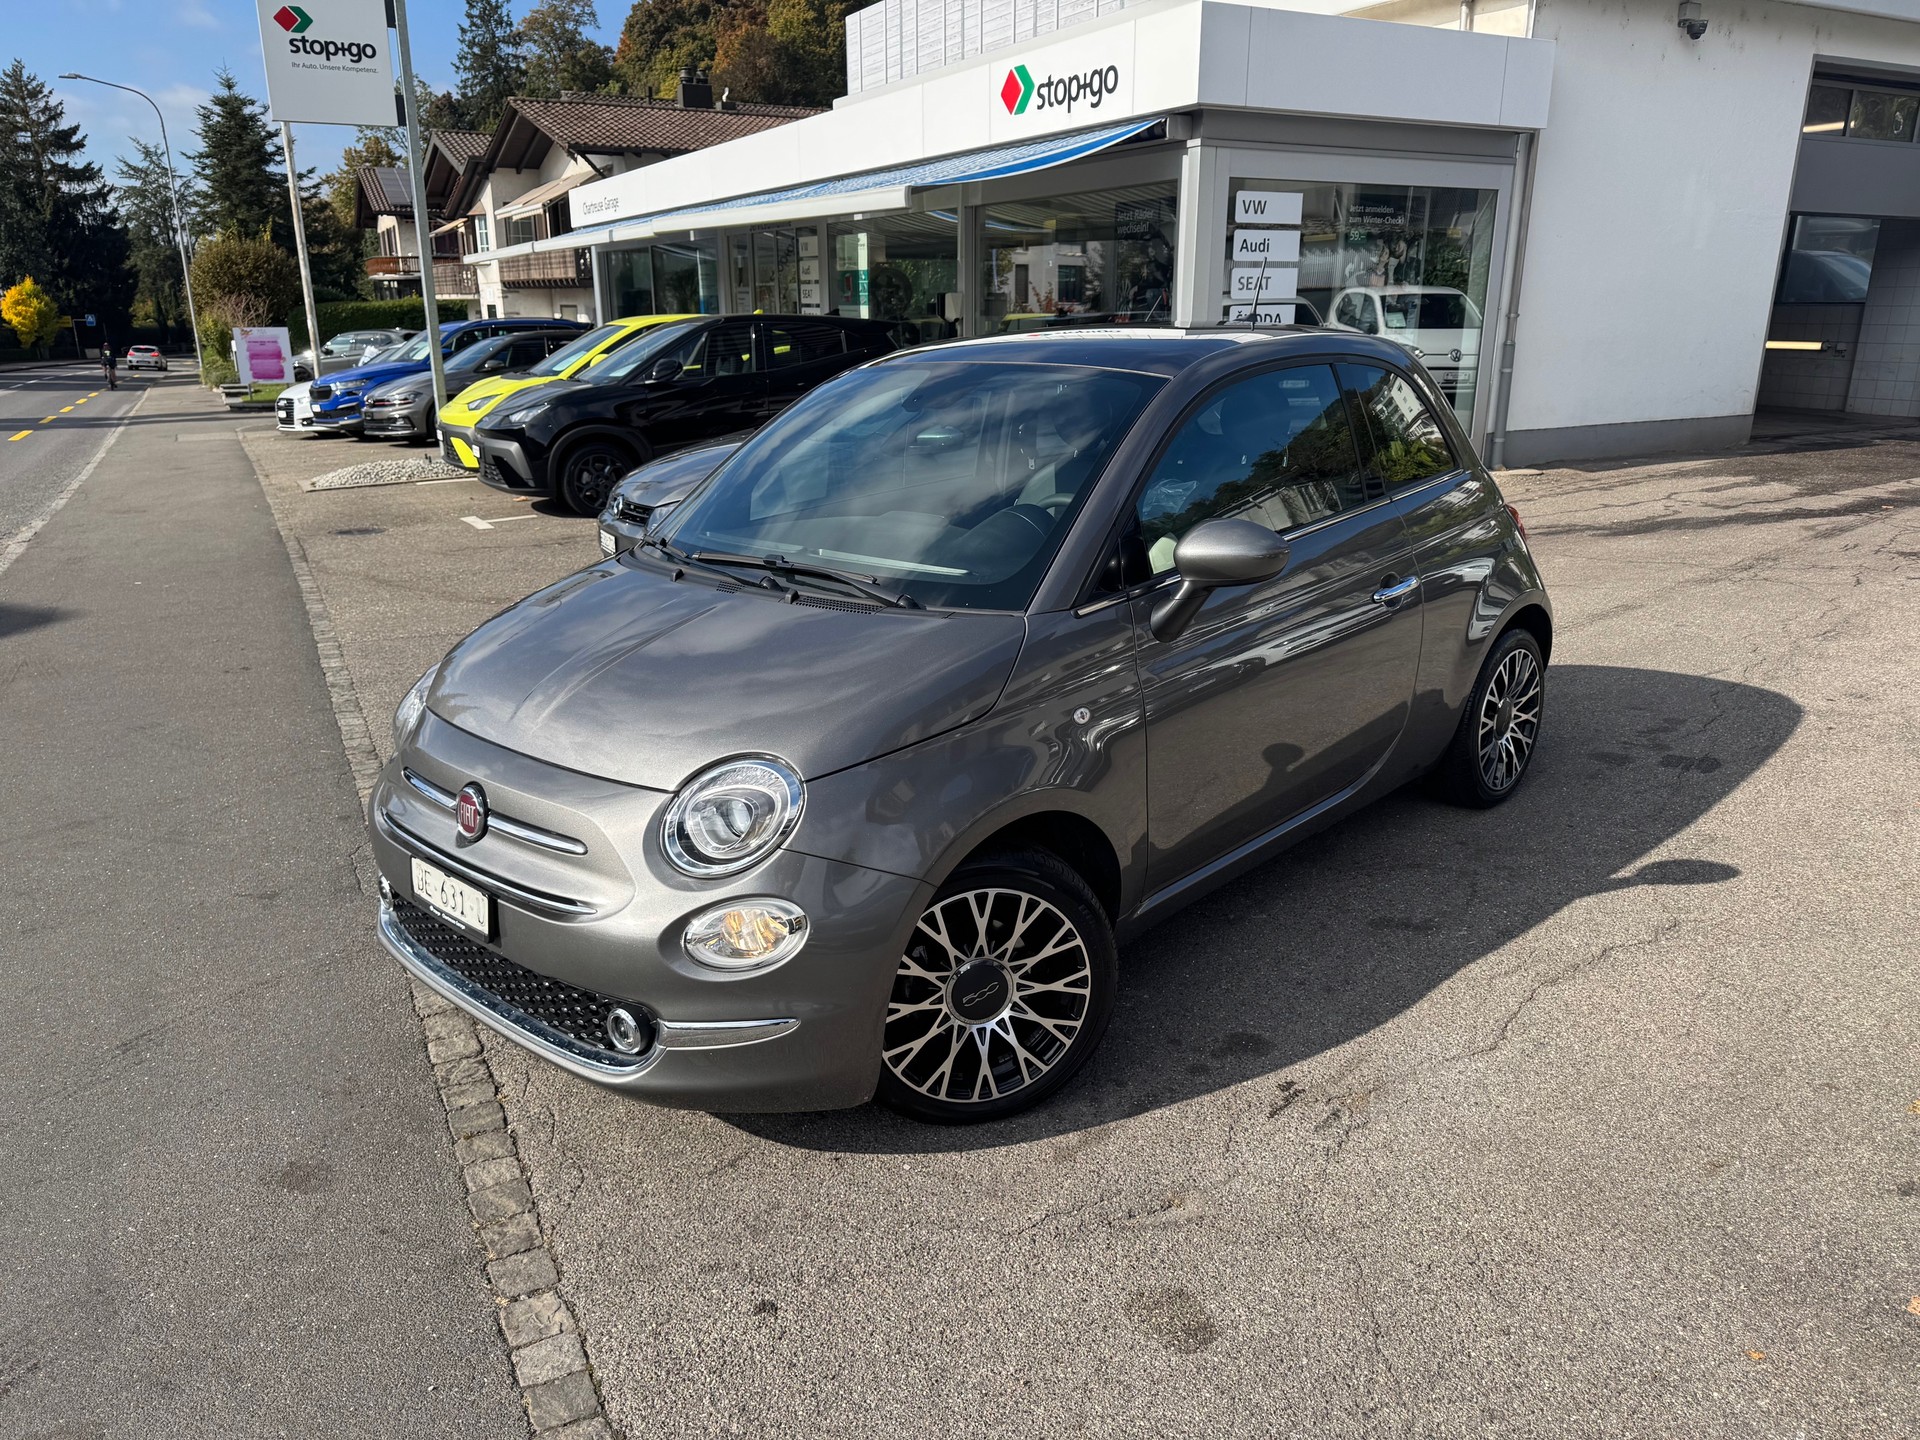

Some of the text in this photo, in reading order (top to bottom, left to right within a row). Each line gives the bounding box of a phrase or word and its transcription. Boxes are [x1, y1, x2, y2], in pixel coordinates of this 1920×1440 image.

[288, 35, 377, 64] stop+go
[291, 61, 380, 74] Ihr Auto. Unsere Kompetenz.
[1037, 64, 1119, 114] stop+go
[1242, 199, 1268, 215] VW
[1349, 204, 1395, 214] Jetzt anmelden
[1239, 238, 1271, 253] Audi
[1237, 276, 1272, 291] SEAT
[460, 801, 477, 828] FIAT
[440, 879, 467, 919] 631
